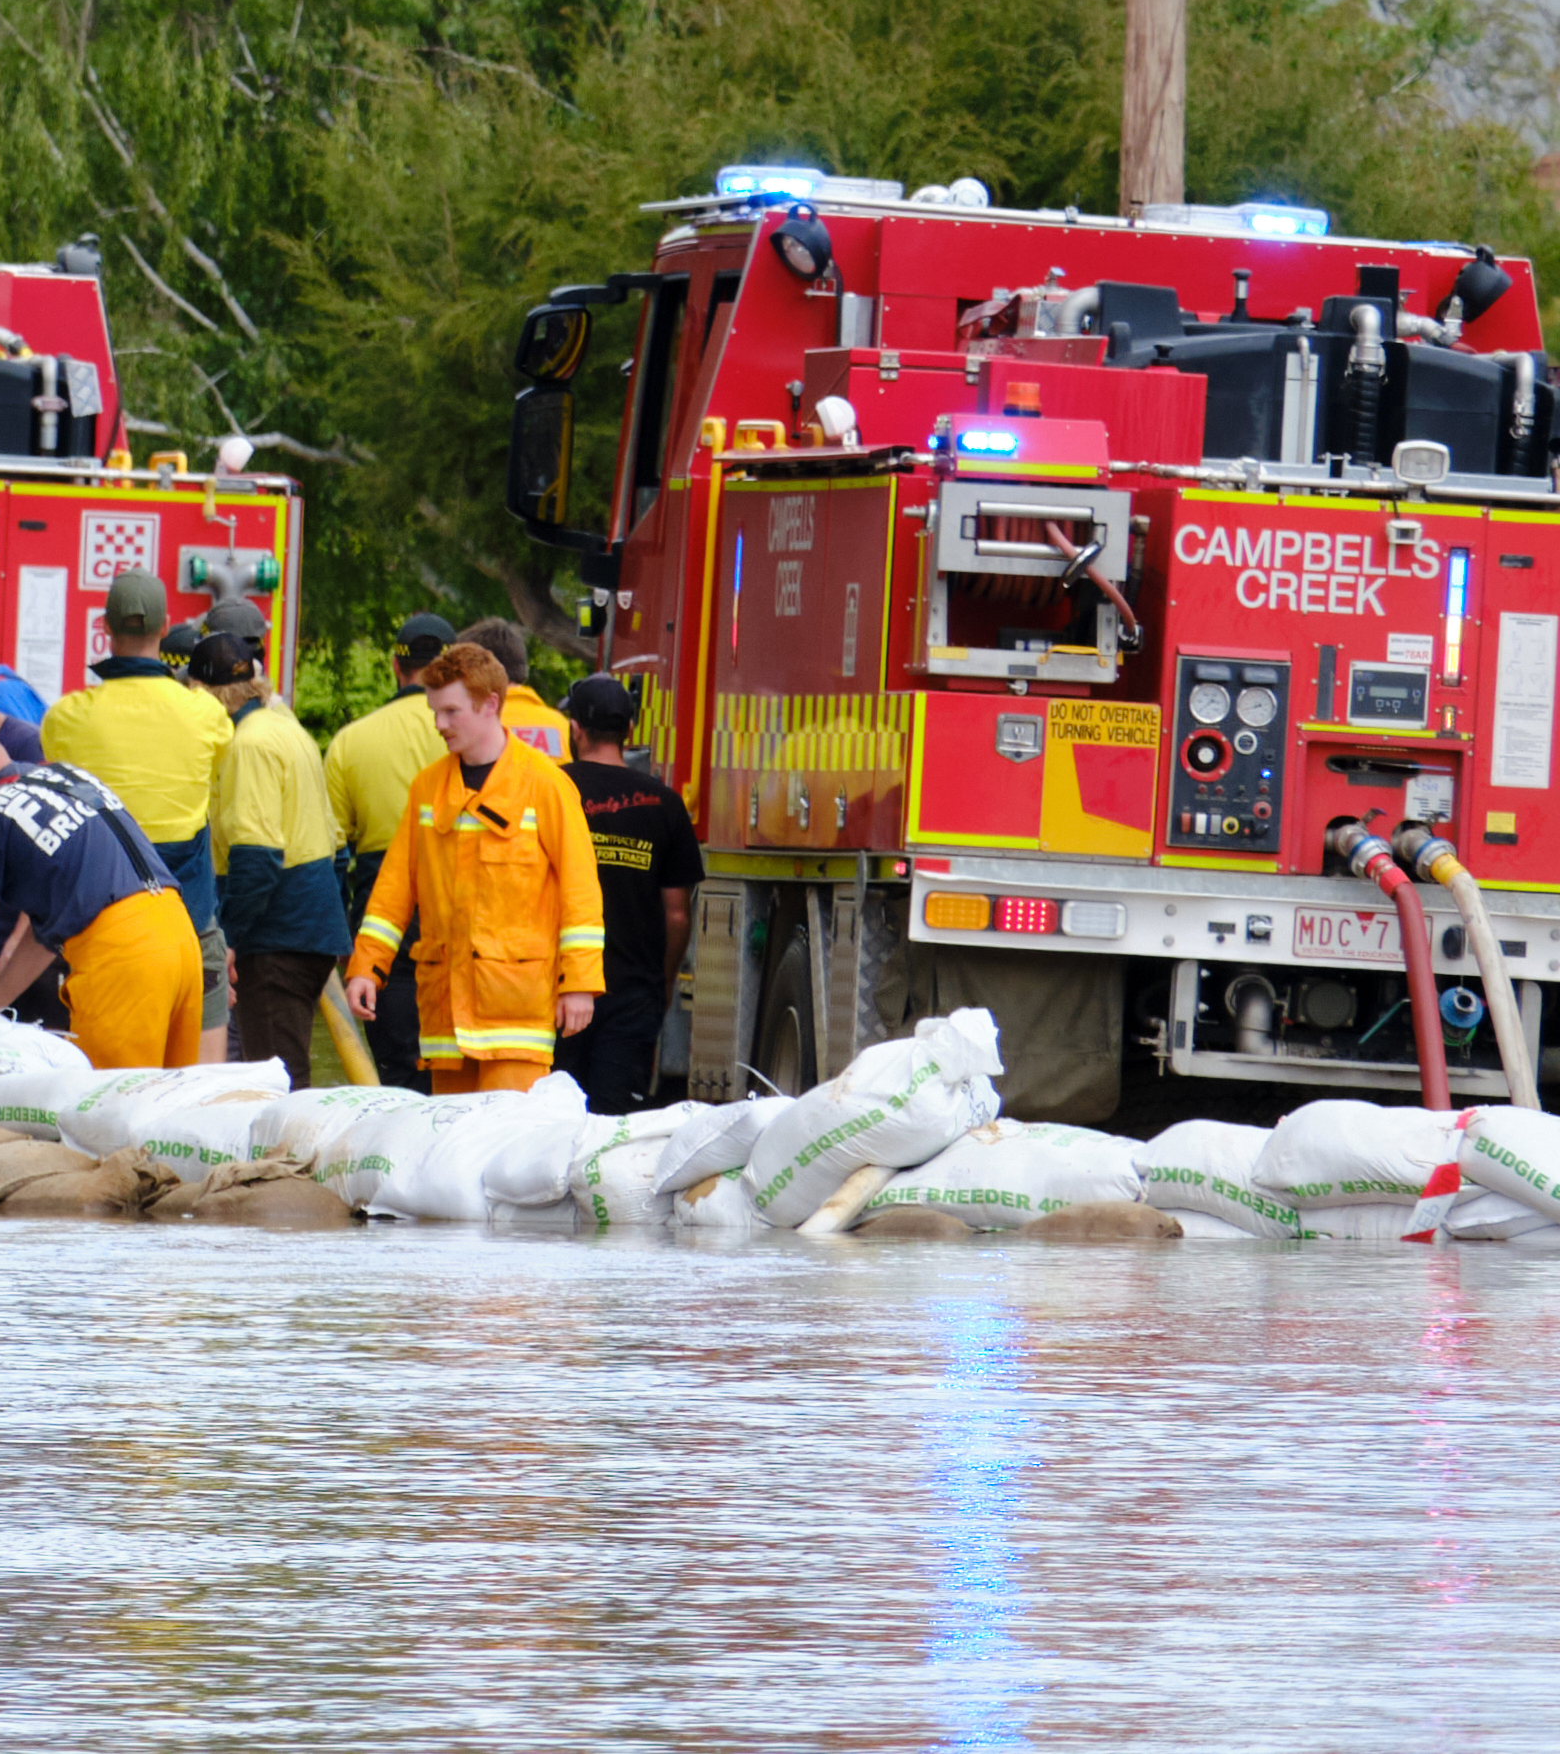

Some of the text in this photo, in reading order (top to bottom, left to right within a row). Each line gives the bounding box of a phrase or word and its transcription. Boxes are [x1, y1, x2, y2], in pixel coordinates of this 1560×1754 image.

[1174, 524, 1441, 580] CAMPBELLS
[1236, 568, 1387, 617] CREEK
[1050, 703, 1157, 726] DO NOT OVERTAKE
[517, 729, 551, 753] FA
[1051, 722, 1157, 745] TURNING VEHICLE
[597, 850, 649, 866] FOR TRADE
[1299, 914, 1352, 948] MDC
[1474, 1135, 1550, 1192] BUDGIE
[869, 1187, 920, 1208] DGIE
[926, 1187, 1031, 1212] BREEDER
